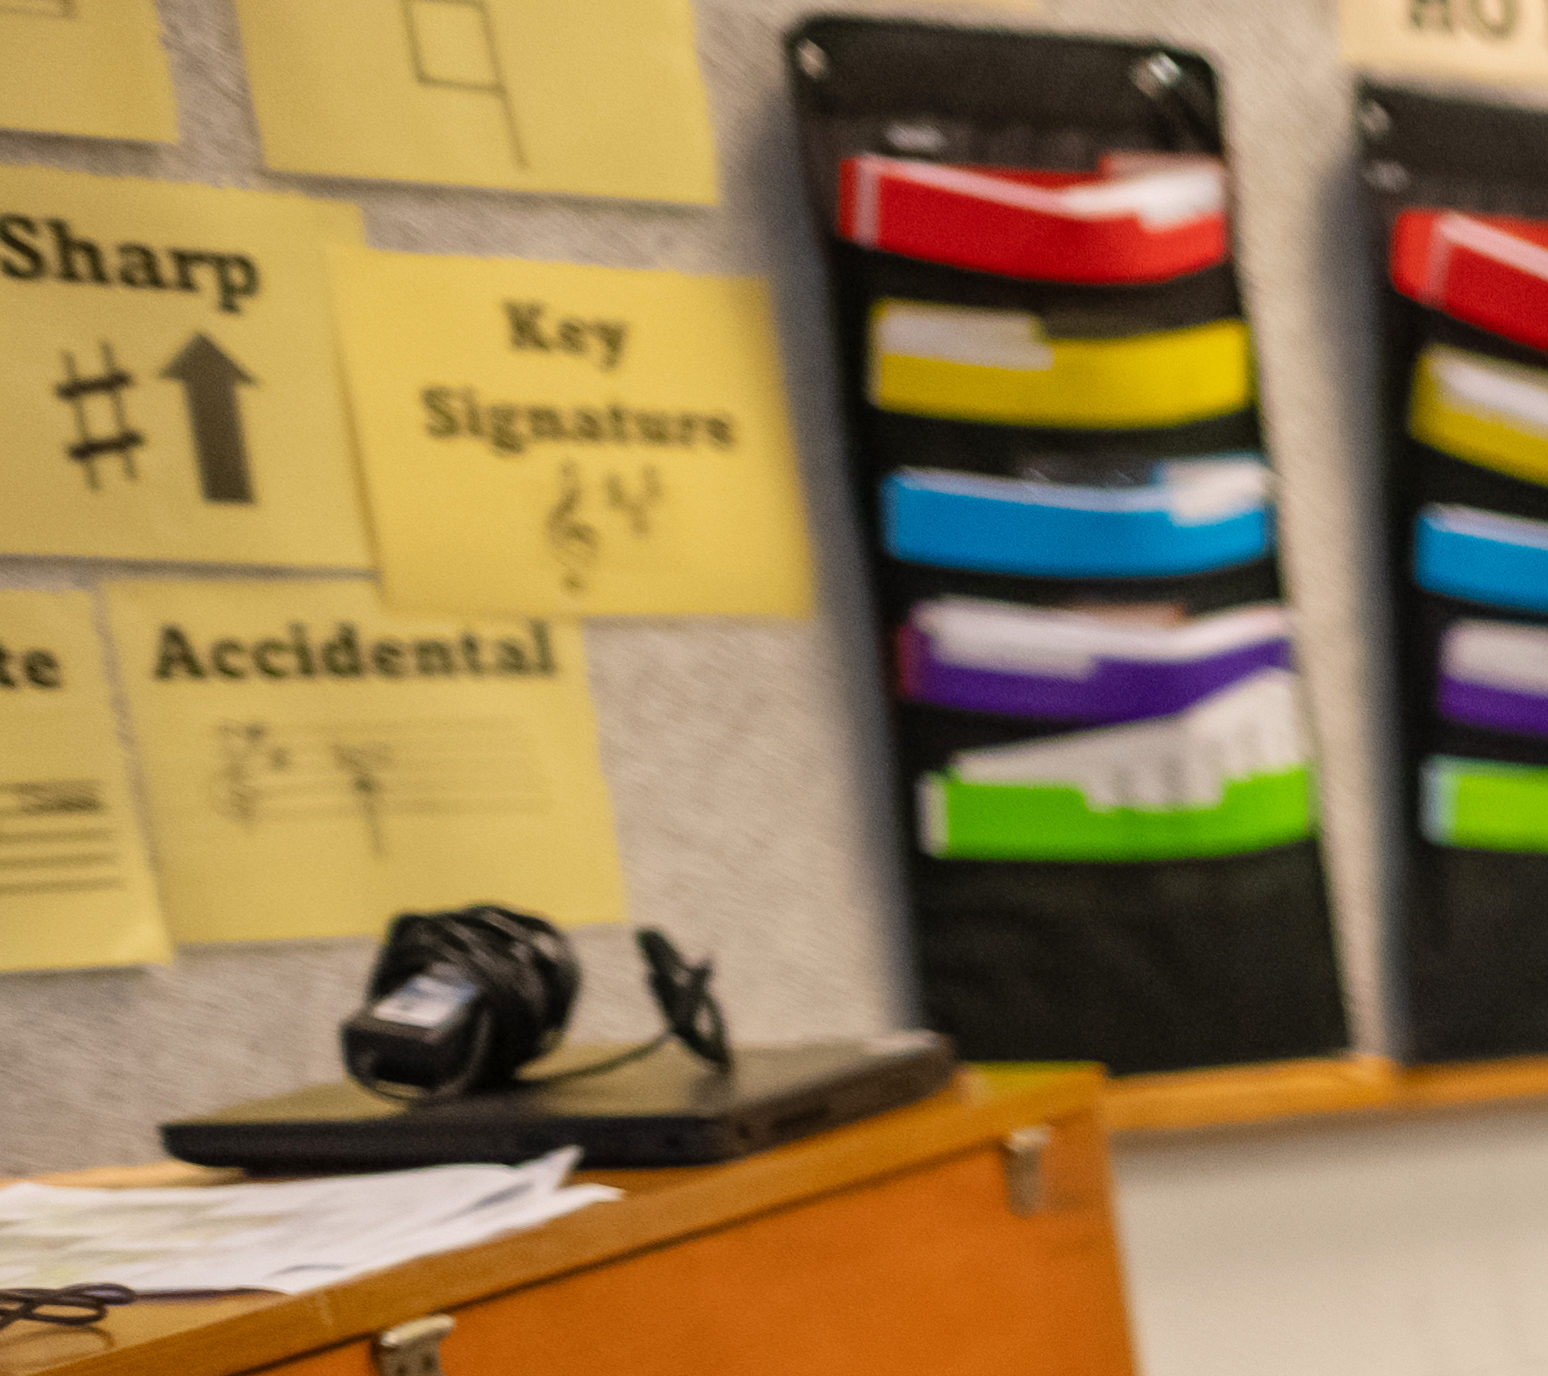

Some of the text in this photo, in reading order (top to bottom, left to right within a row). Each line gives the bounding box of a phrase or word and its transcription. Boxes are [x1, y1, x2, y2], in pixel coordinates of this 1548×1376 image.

[0, 214, 260, 314] Sharp
[503, 300, 628, 372] Key
[420, 384, 738, 457] Signature
[155, 618, 557, 680] Accidental
